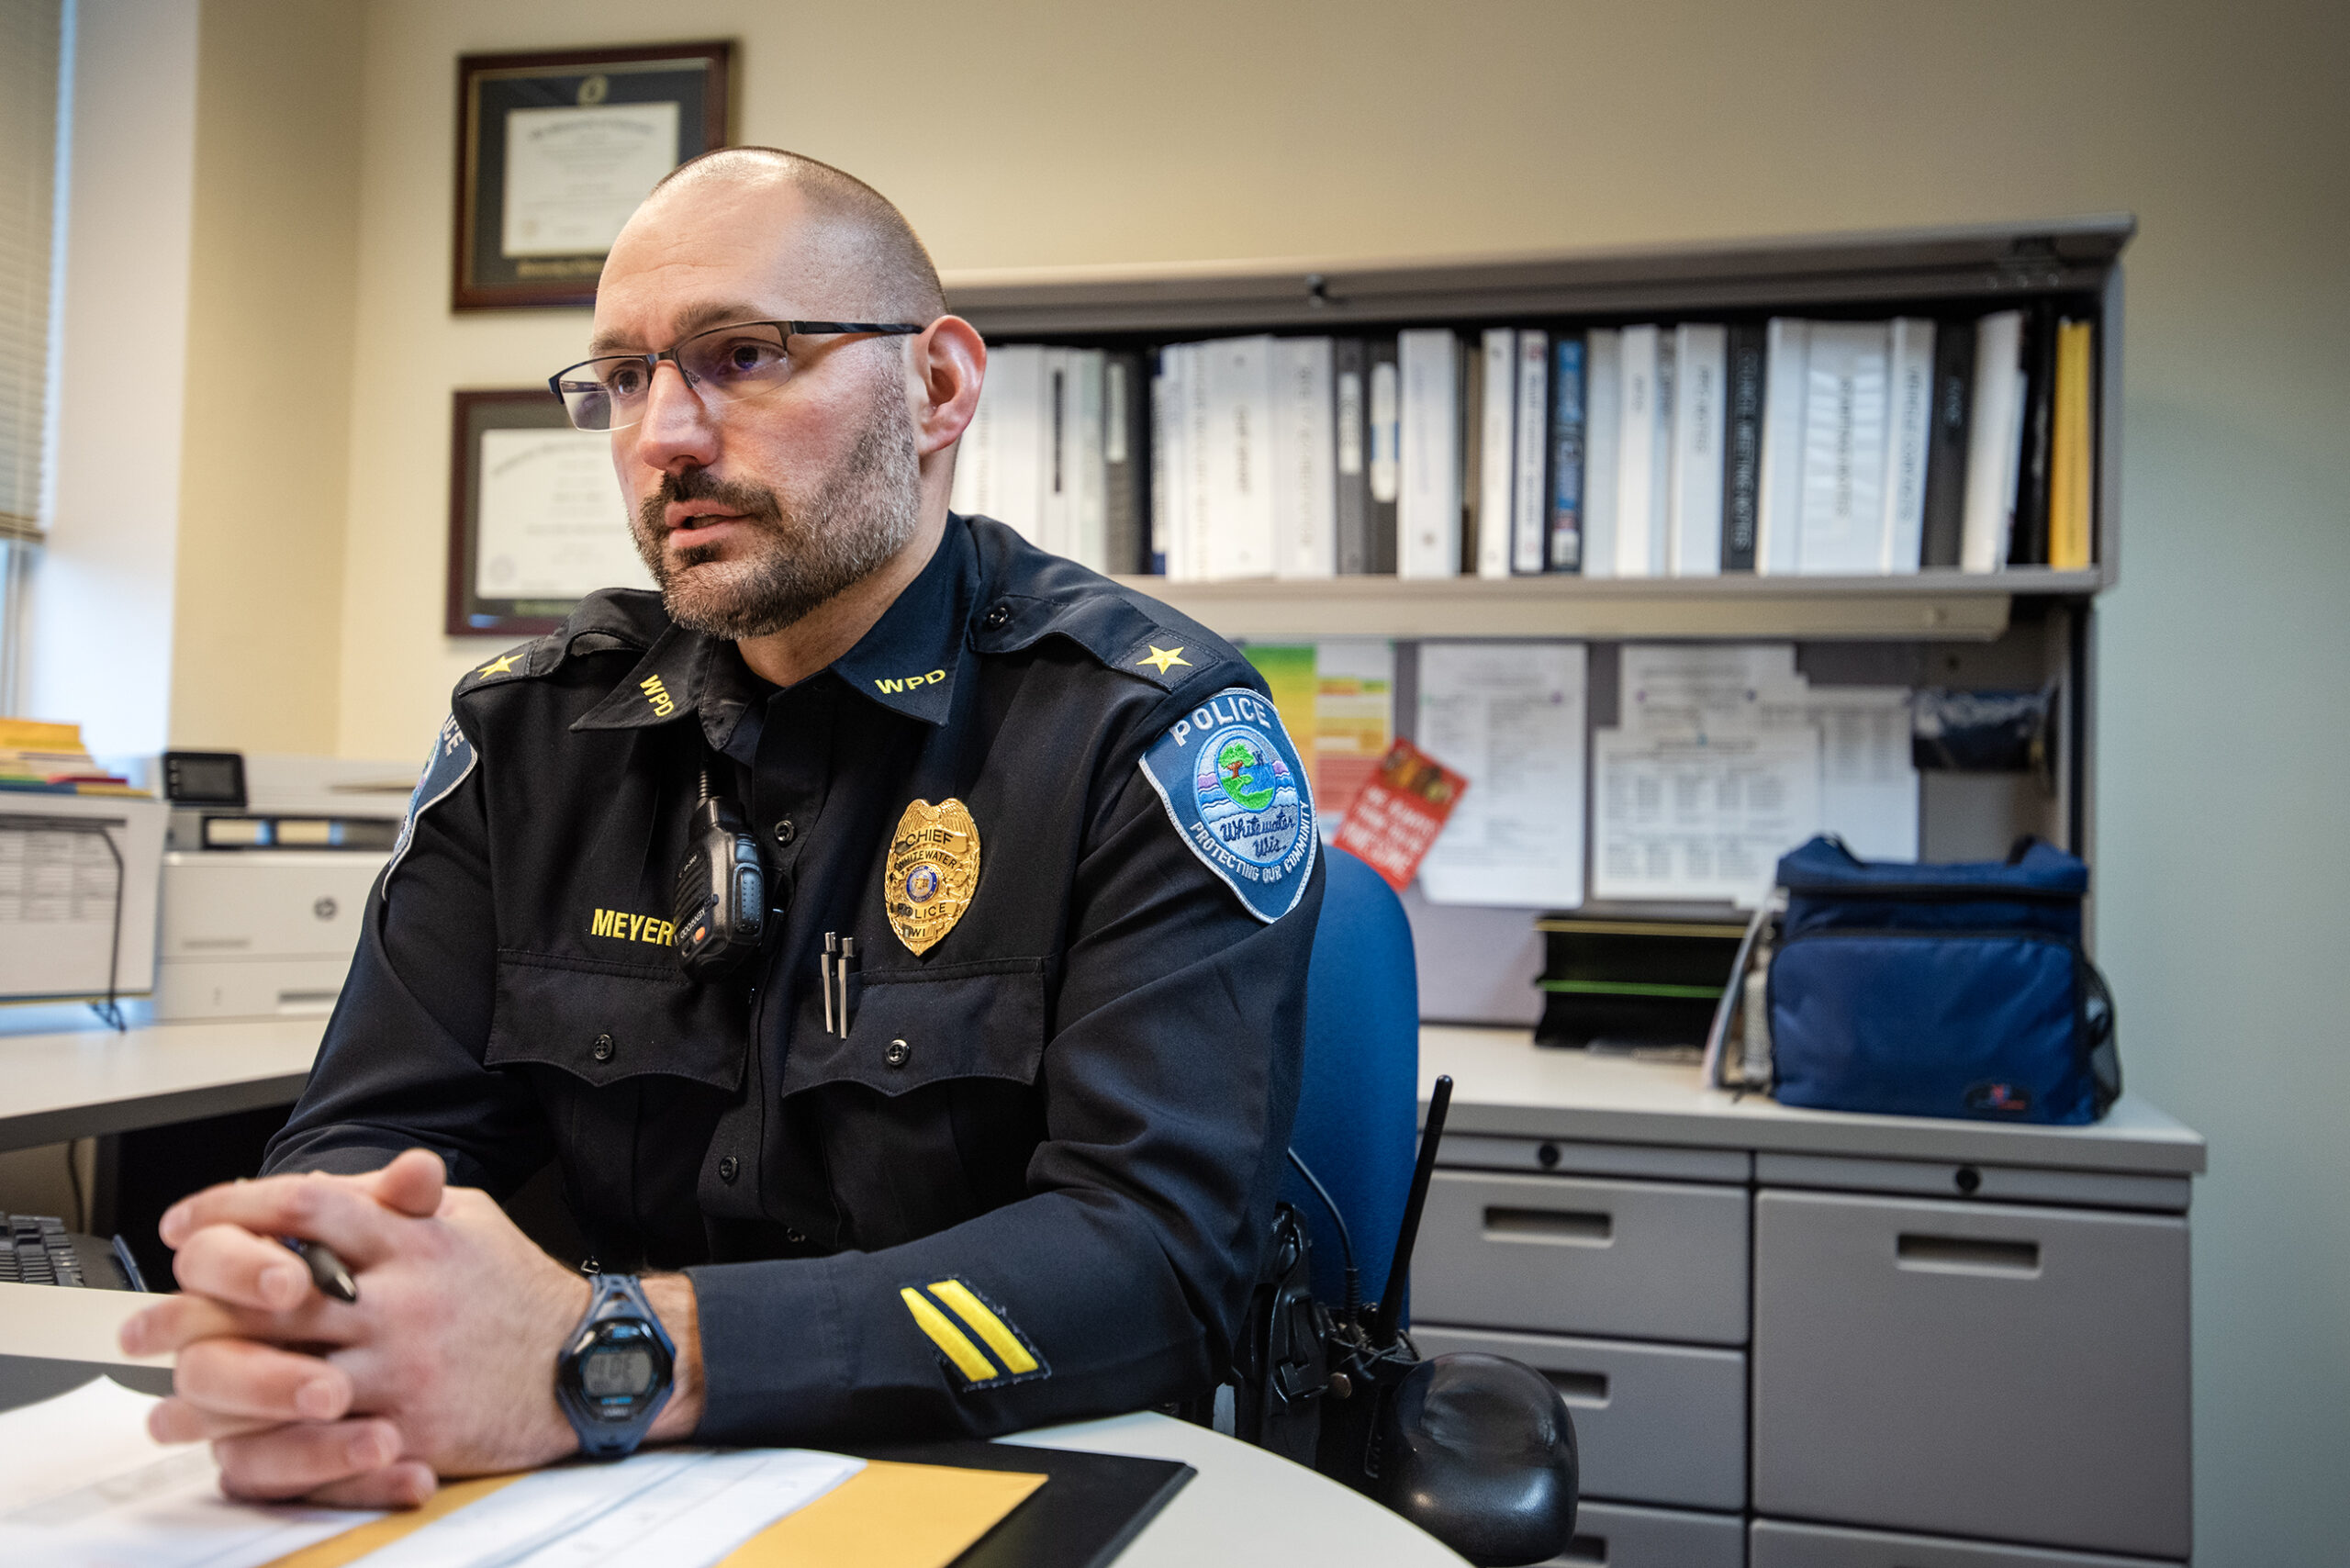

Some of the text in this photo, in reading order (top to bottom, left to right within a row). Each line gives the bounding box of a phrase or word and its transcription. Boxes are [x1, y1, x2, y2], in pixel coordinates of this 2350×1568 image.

[639, 673, 675, 717] WPD
[874, 669, 946, 695] WPD
[442, 713, 465, 757] ICE
[1169, 697, 1271, 747] POLICE
[905, 829, 954, 846] CHIEF
[1190, 821, 1260, 882] PROTECTING
[1261, 865, 1282, 884] OUR
[1283, 800, 1311, 874] COMMUNITY
[1219, 809, 1297, 842] Whitewater
[898, 850, 957, 870] WHITEWATER
[590, 907, 676, 947] MEYER
[897, 902, 946, 919] POLICE
